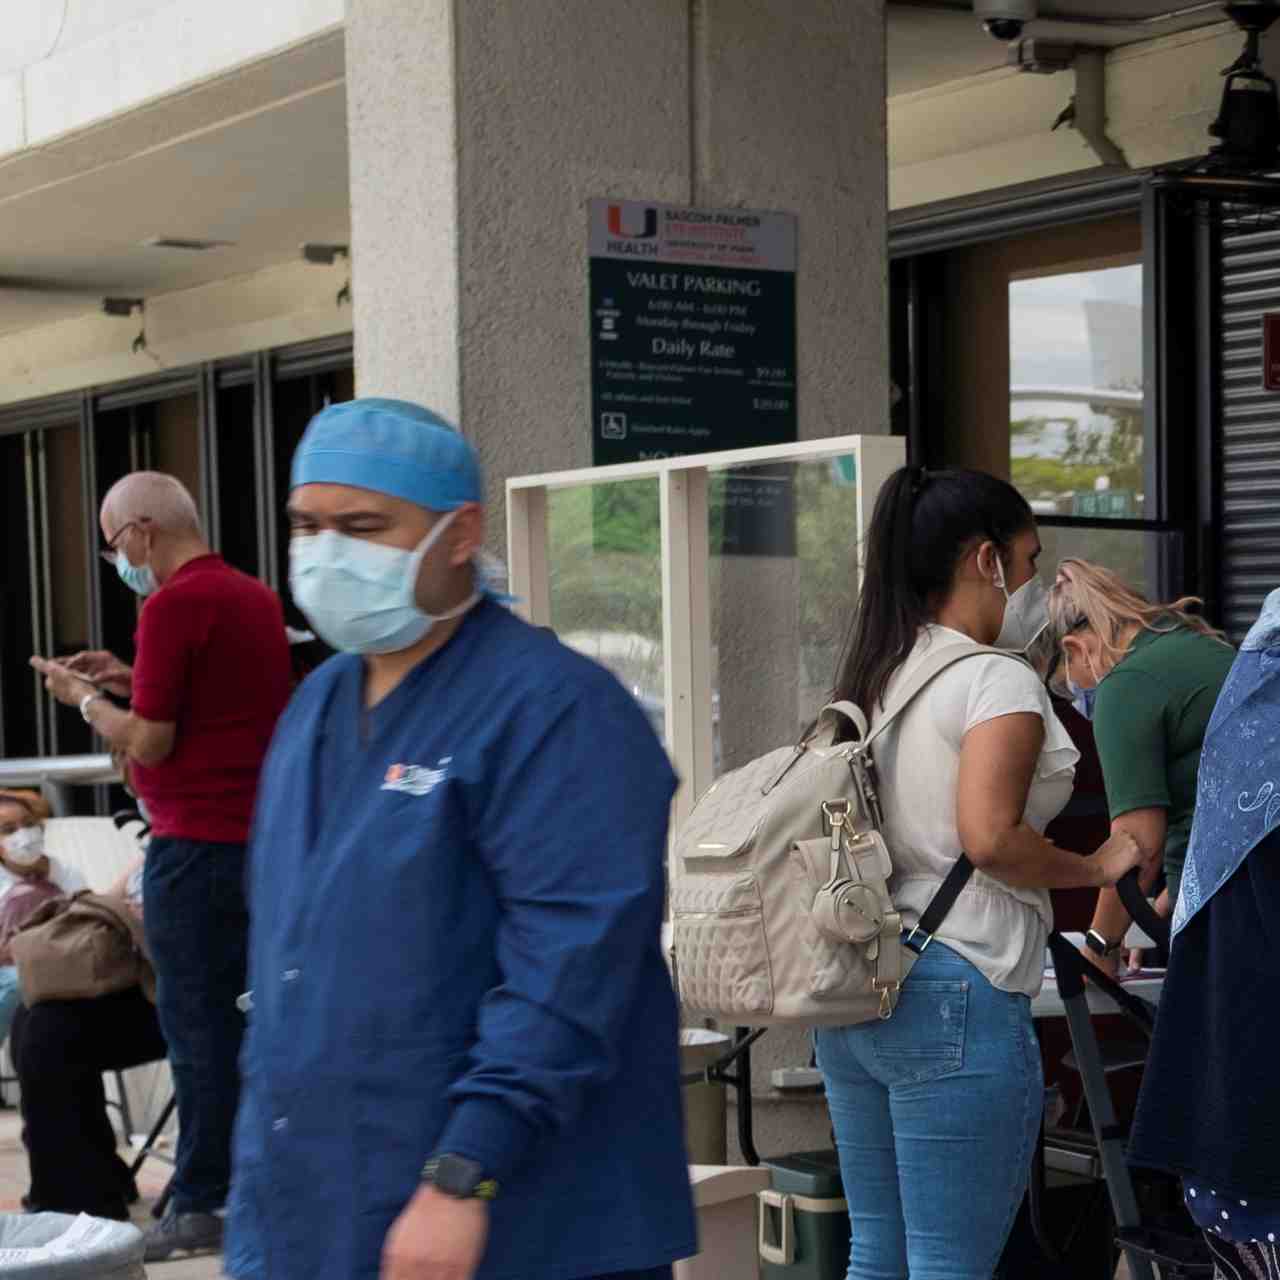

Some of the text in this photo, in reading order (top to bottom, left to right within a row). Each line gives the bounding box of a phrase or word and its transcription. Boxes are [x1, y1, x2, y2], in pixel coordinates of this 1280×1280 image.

[608, 206, 657, 239] U
[607, 240, 659, 256] HEALTH
[626, 271, 761, 296] VALET PARKING
[651, 337, 736, 360] Daily Rate
